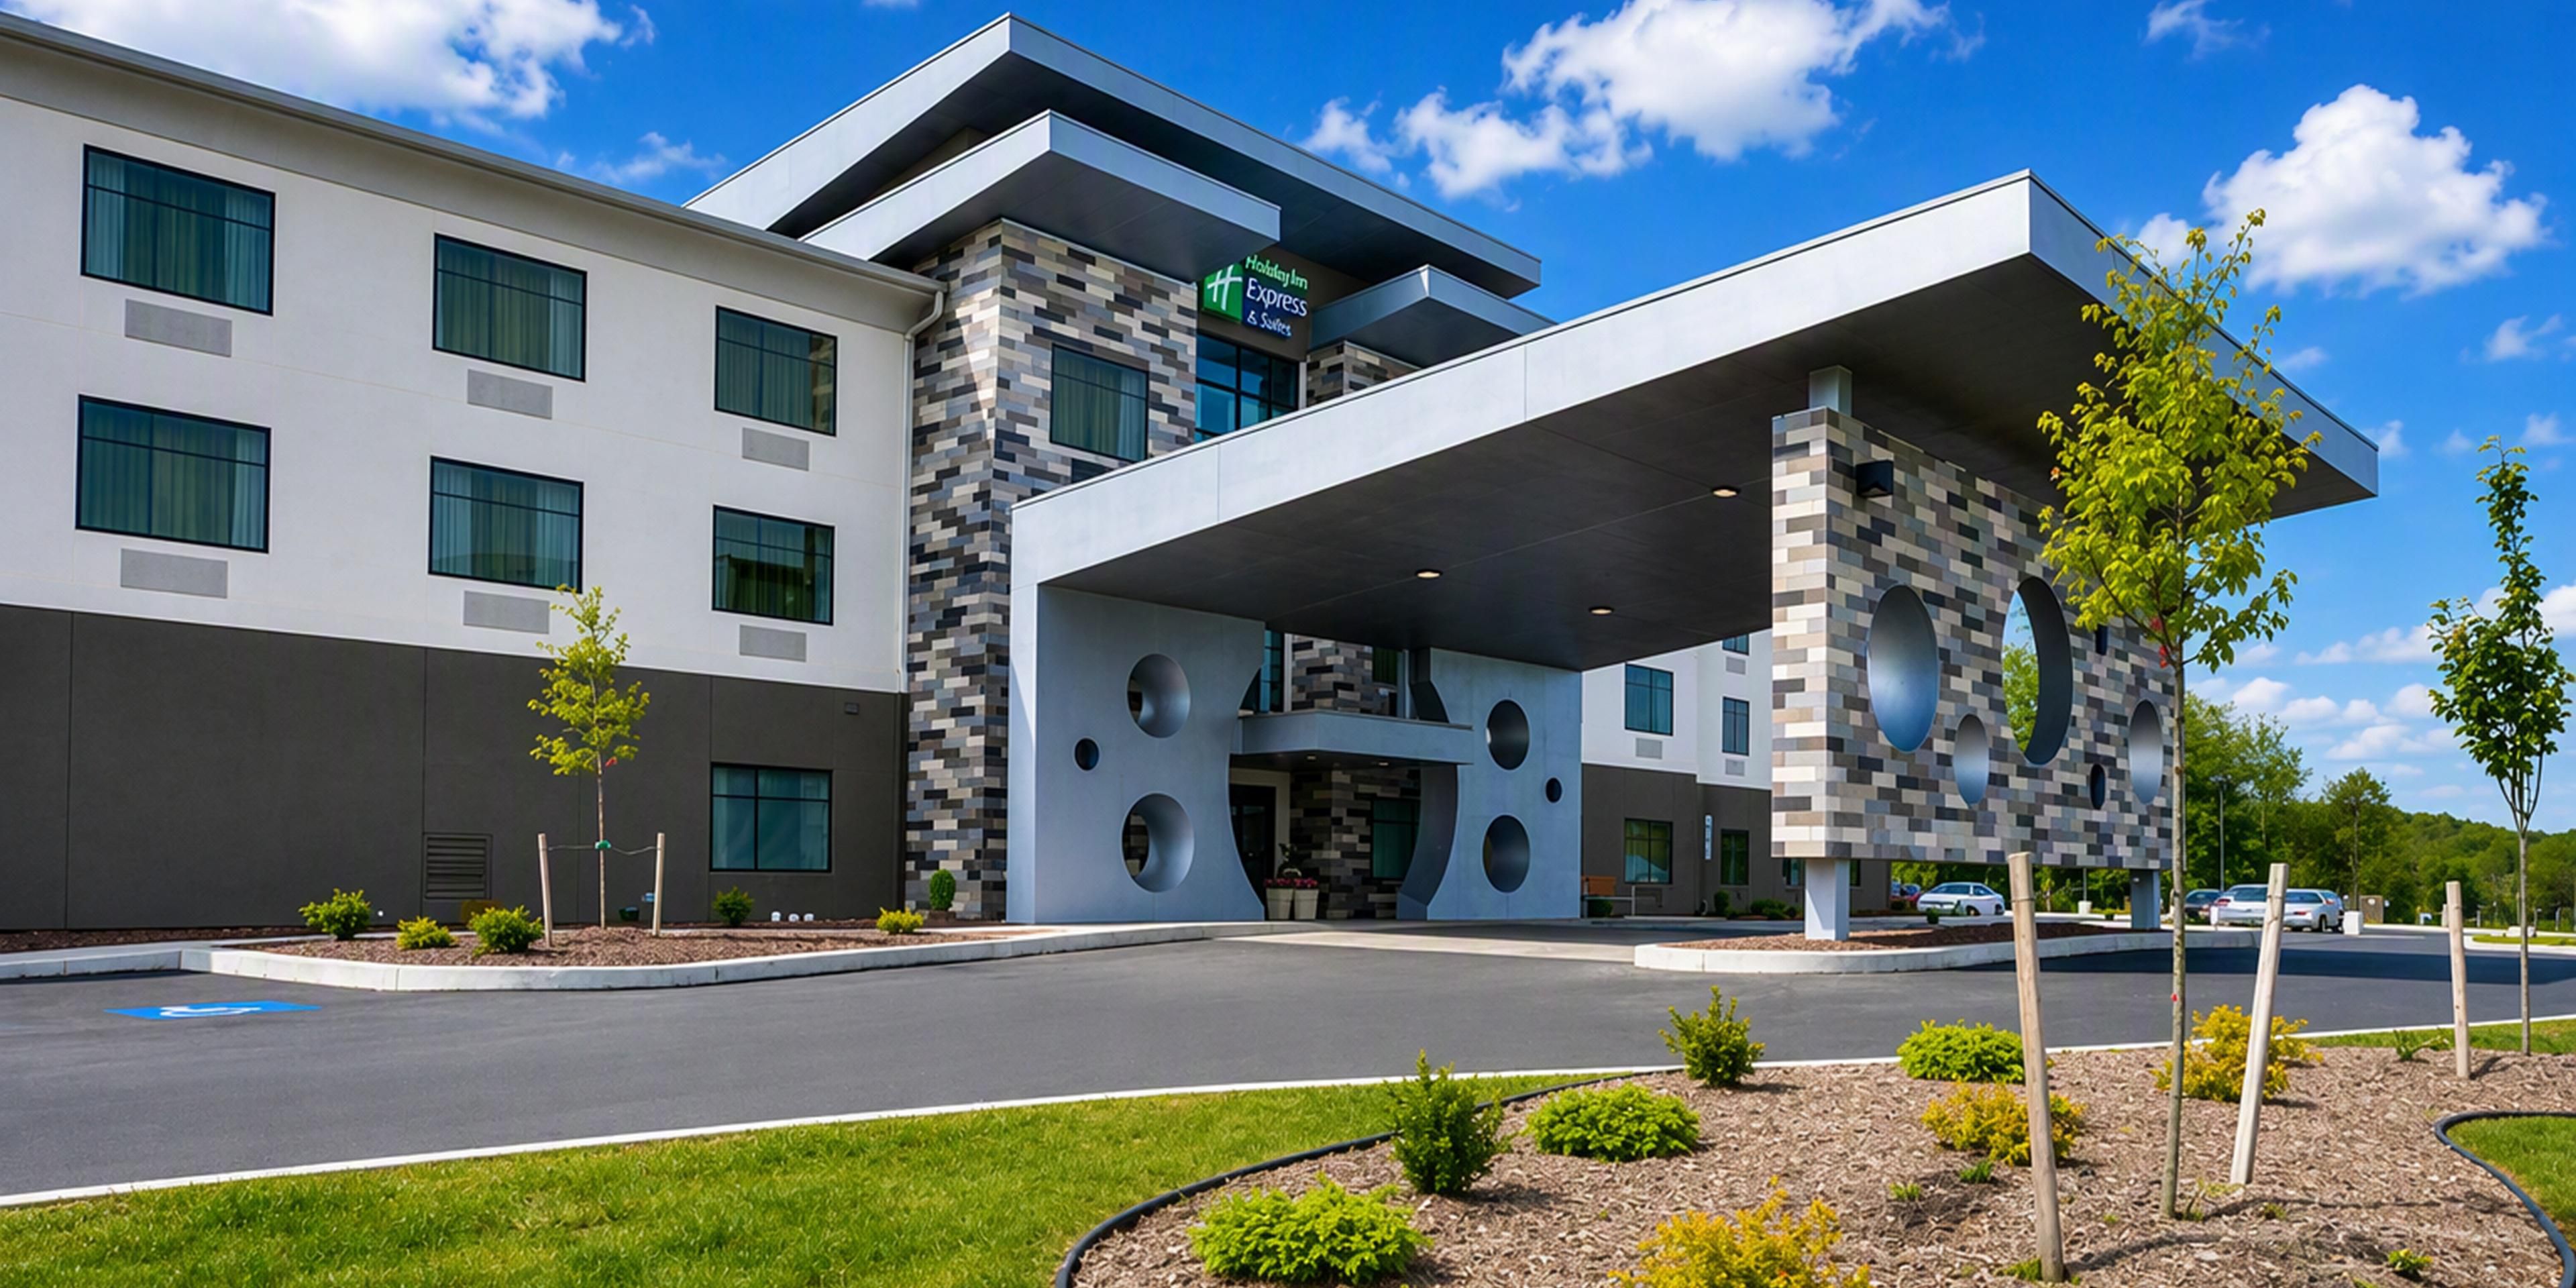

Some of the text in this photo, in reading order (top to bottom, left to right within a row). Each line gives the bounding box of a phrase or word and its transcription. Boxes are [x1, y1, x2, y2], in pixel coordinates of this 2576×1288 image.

[1245, 255, 1307, 290] Holiday Inn
[1246, 277, 1307, 317] Express
[1247, 310, 1258, 326] &
